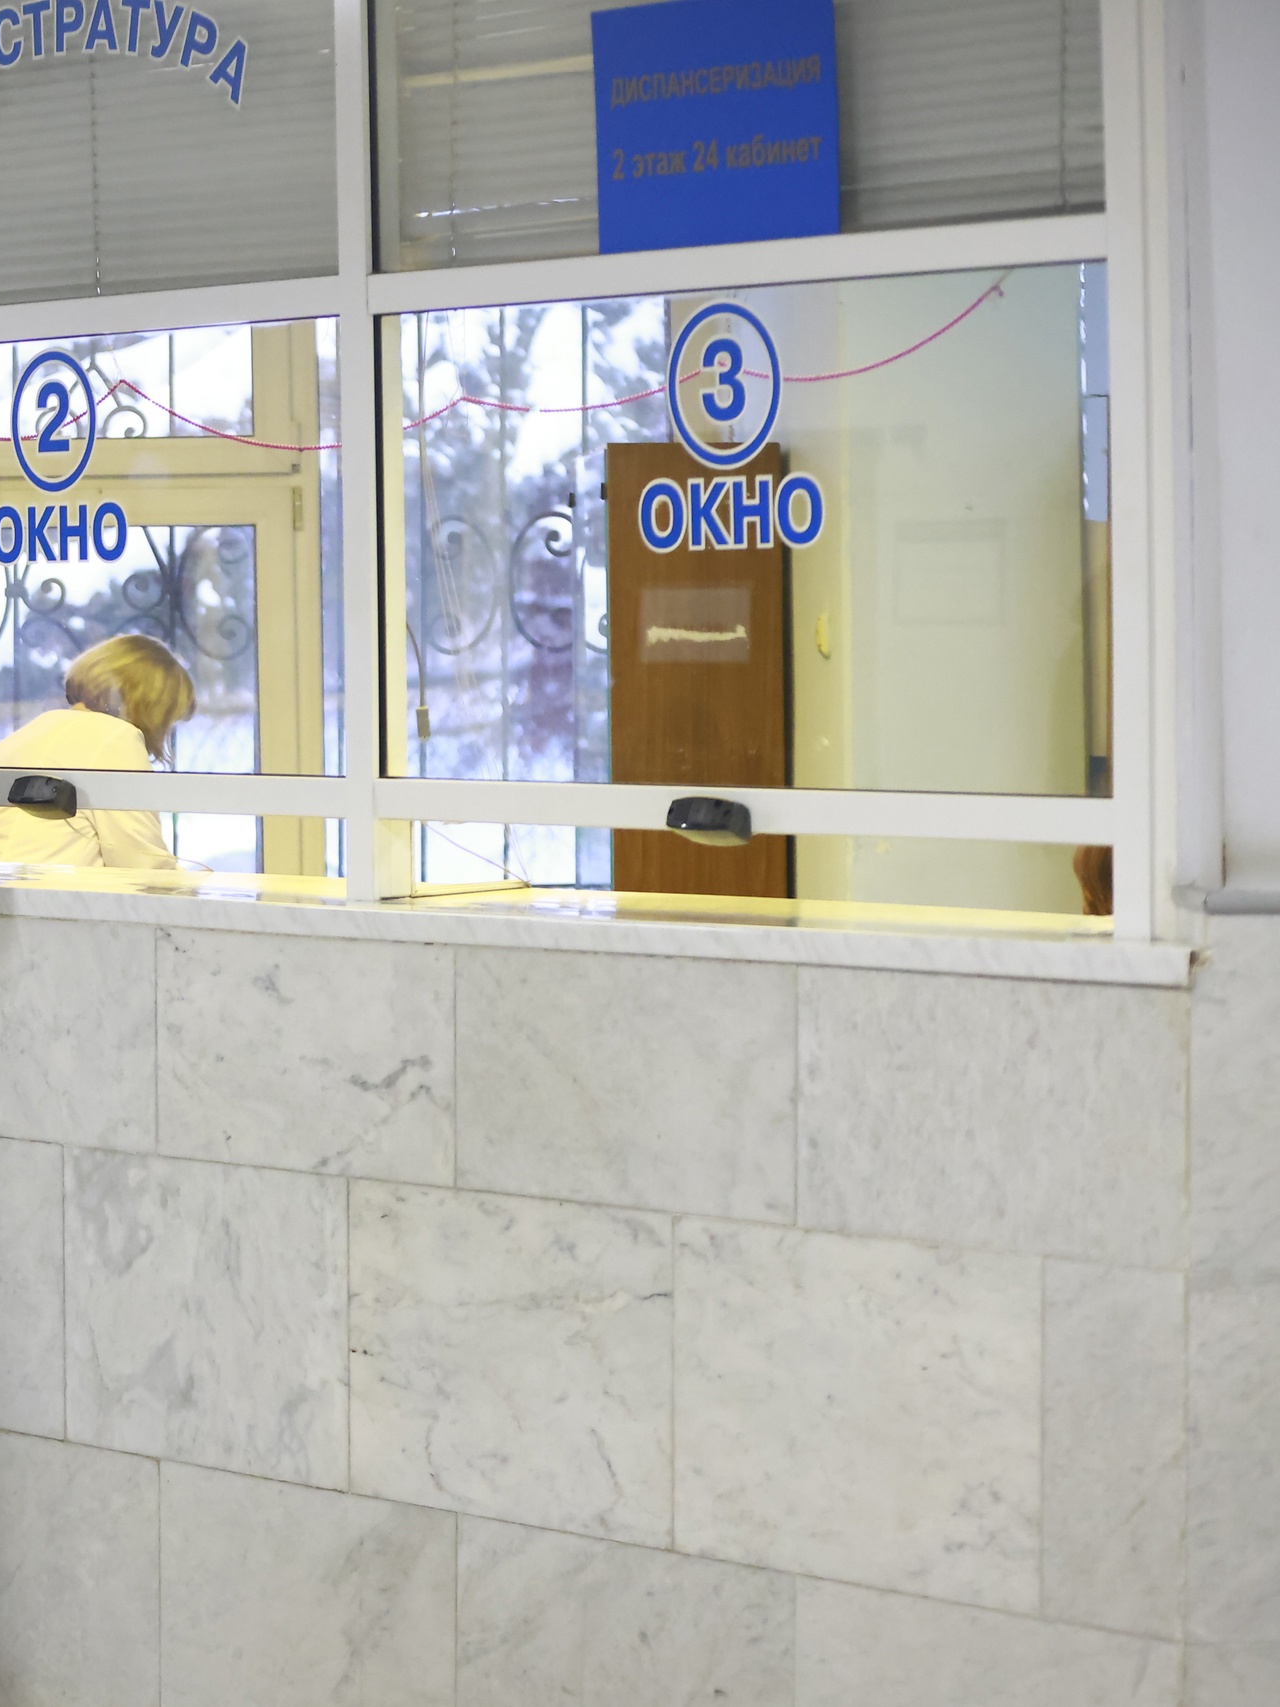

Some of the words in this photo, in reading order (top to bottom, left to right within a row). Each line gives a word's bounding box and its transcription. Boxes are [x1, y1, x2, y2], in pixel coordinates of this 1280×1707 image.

[610, 54, 821, 109] ДИСПАНСЕРИЗАЦИЯ
[612, 148, 625, 180] 2
[631, 148, 686, 179] этаж
[692, 139, 719, 173] 24
[726, 134, 823, 168] кабинет
[700, 336, 746, 422] 3
[37, 380, 70, 454] 2
[638, 471, 825, 553] ОКНО
